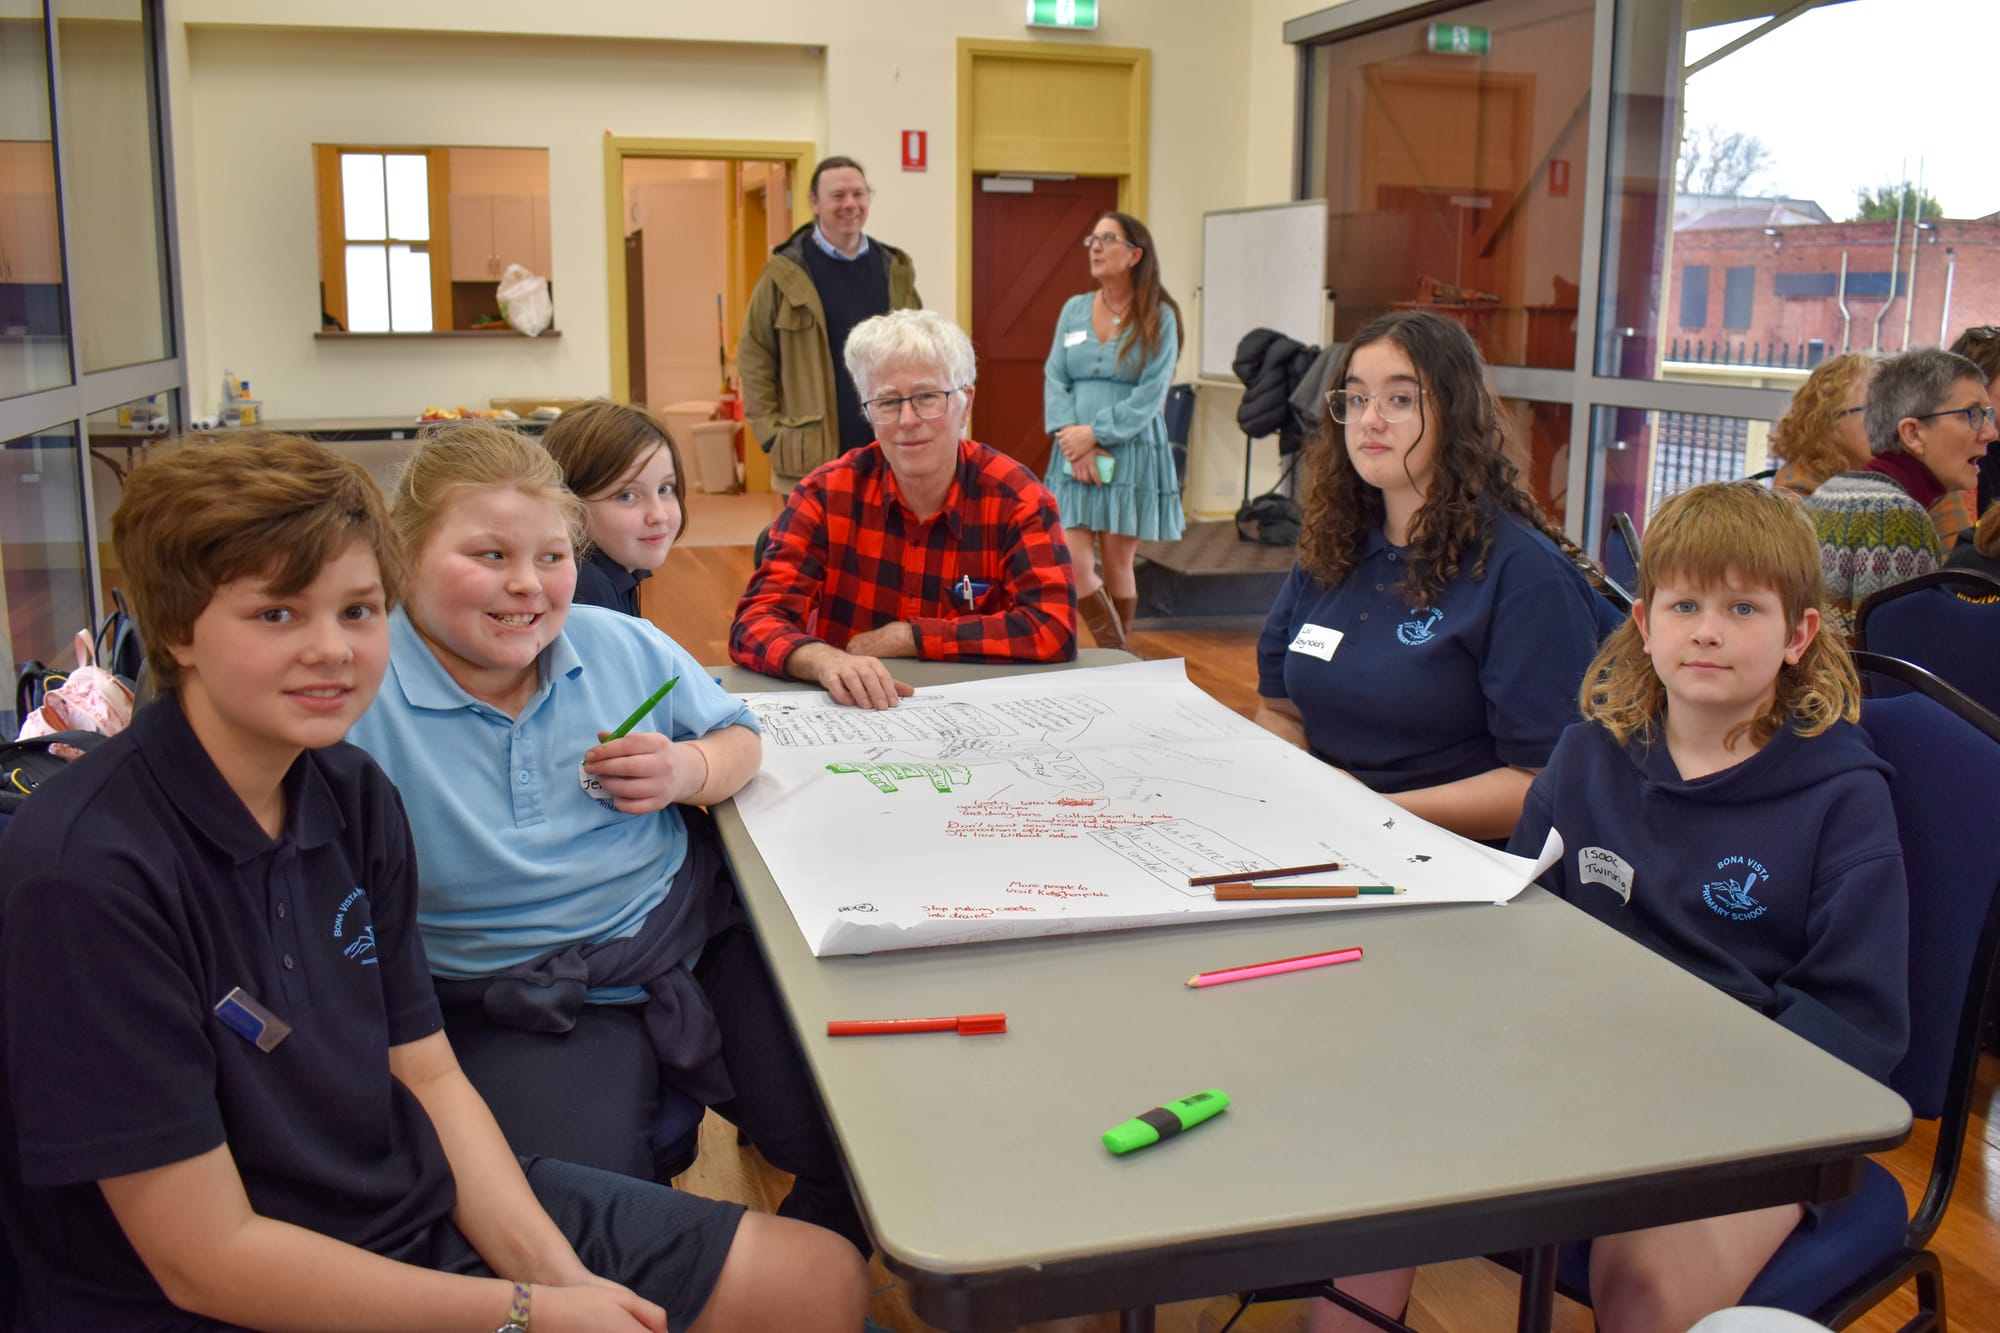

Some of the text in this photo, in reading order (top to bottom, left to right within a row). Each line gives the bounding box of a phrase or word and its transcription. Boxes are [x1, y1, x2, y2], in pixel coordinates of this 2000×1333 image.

[1717, 855, 1769, 881] BONA VISTA
[1702, 884, 1767, 920] PRIMARY SCHOOL
[334, 913, 344, 936] BONA
